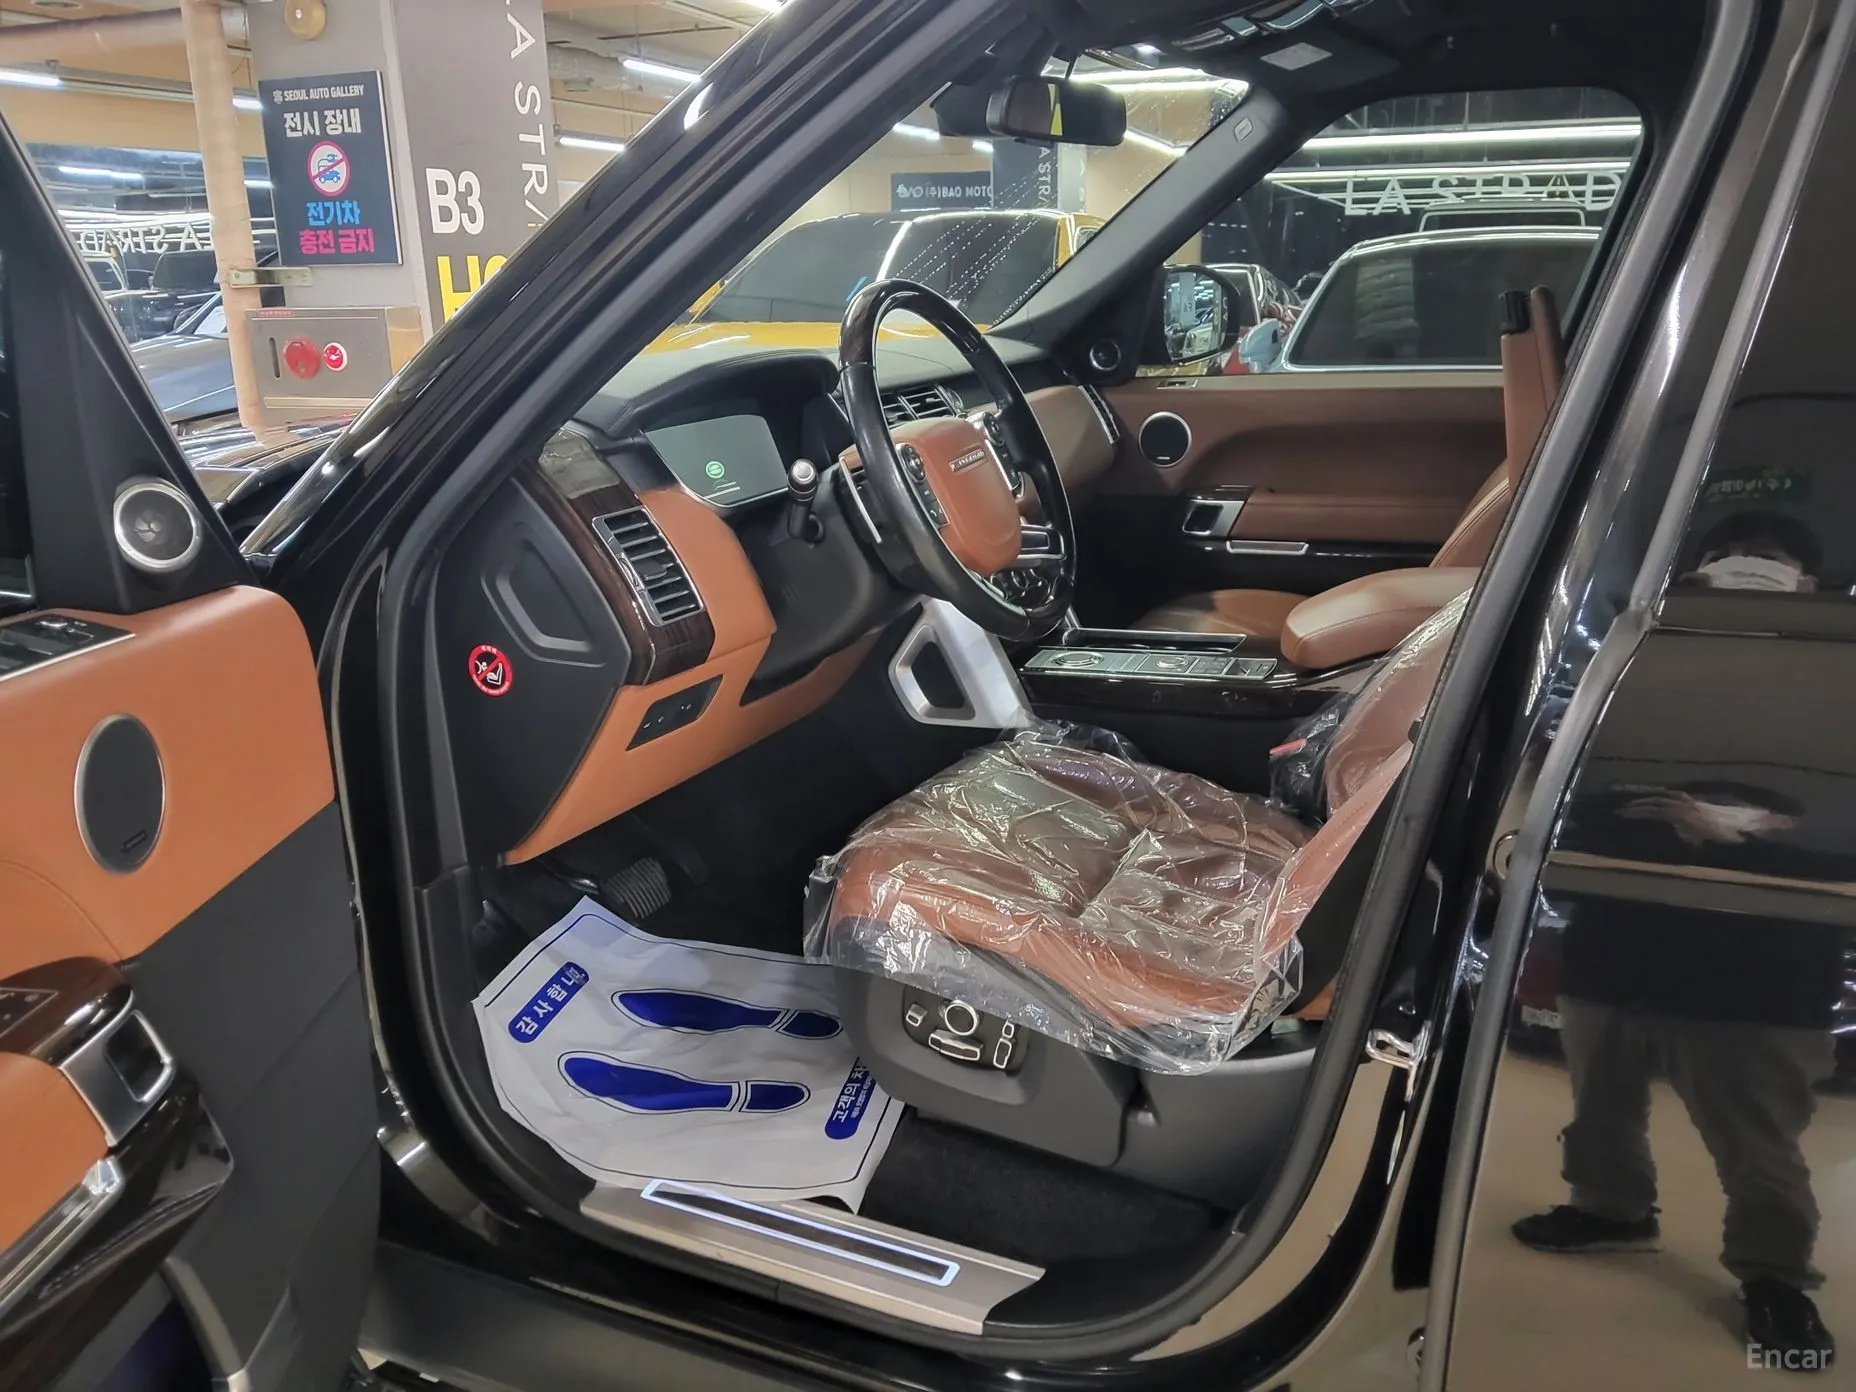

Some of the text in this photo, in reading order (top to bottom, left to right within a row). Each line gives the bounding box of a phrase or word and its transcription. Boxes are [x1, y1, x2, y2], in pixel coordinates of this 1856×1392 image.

[506, 0, 536, 59] A
[284, 85, 365, 101] SEOUL AUTO GALLERY
[284, 108, 362, 138] 전시 장내
[306, 200, 361, 226] 전기차
[425, 167, 485, 236] B3
[1345, 175, 1411, 216] LA
[299, 228, 375, 255] 충전 금지
[832, 1082, 862, 1123] 고객의
